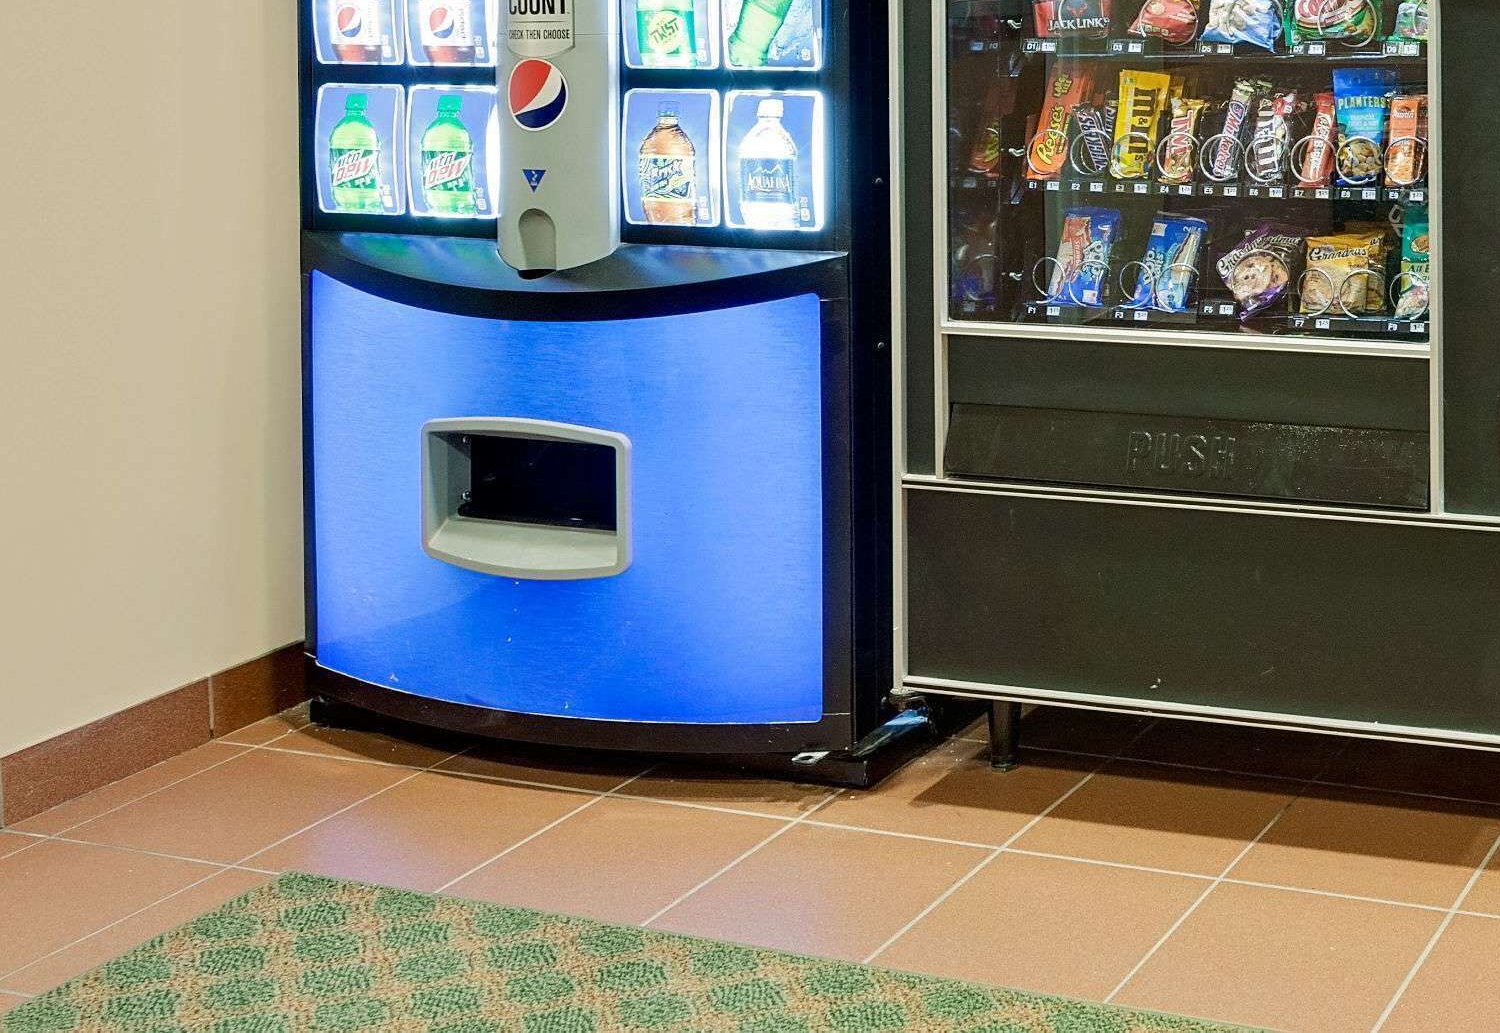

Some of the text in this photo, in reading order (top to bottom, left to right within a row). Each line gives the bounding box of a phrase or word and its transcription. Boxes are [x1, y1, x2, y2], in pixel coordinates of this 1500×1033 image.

[1047, 18, 1077, 31] JACK
[508, 28, 571, 40] CHECK THEN CHOOSE
[1338, 95, 1386, 110] PLANTERS
[1028, 181, 1037, 189] E1
[1294, 320, 1304, 328] F7
[1127, 430, 1237, 471] PUSH
